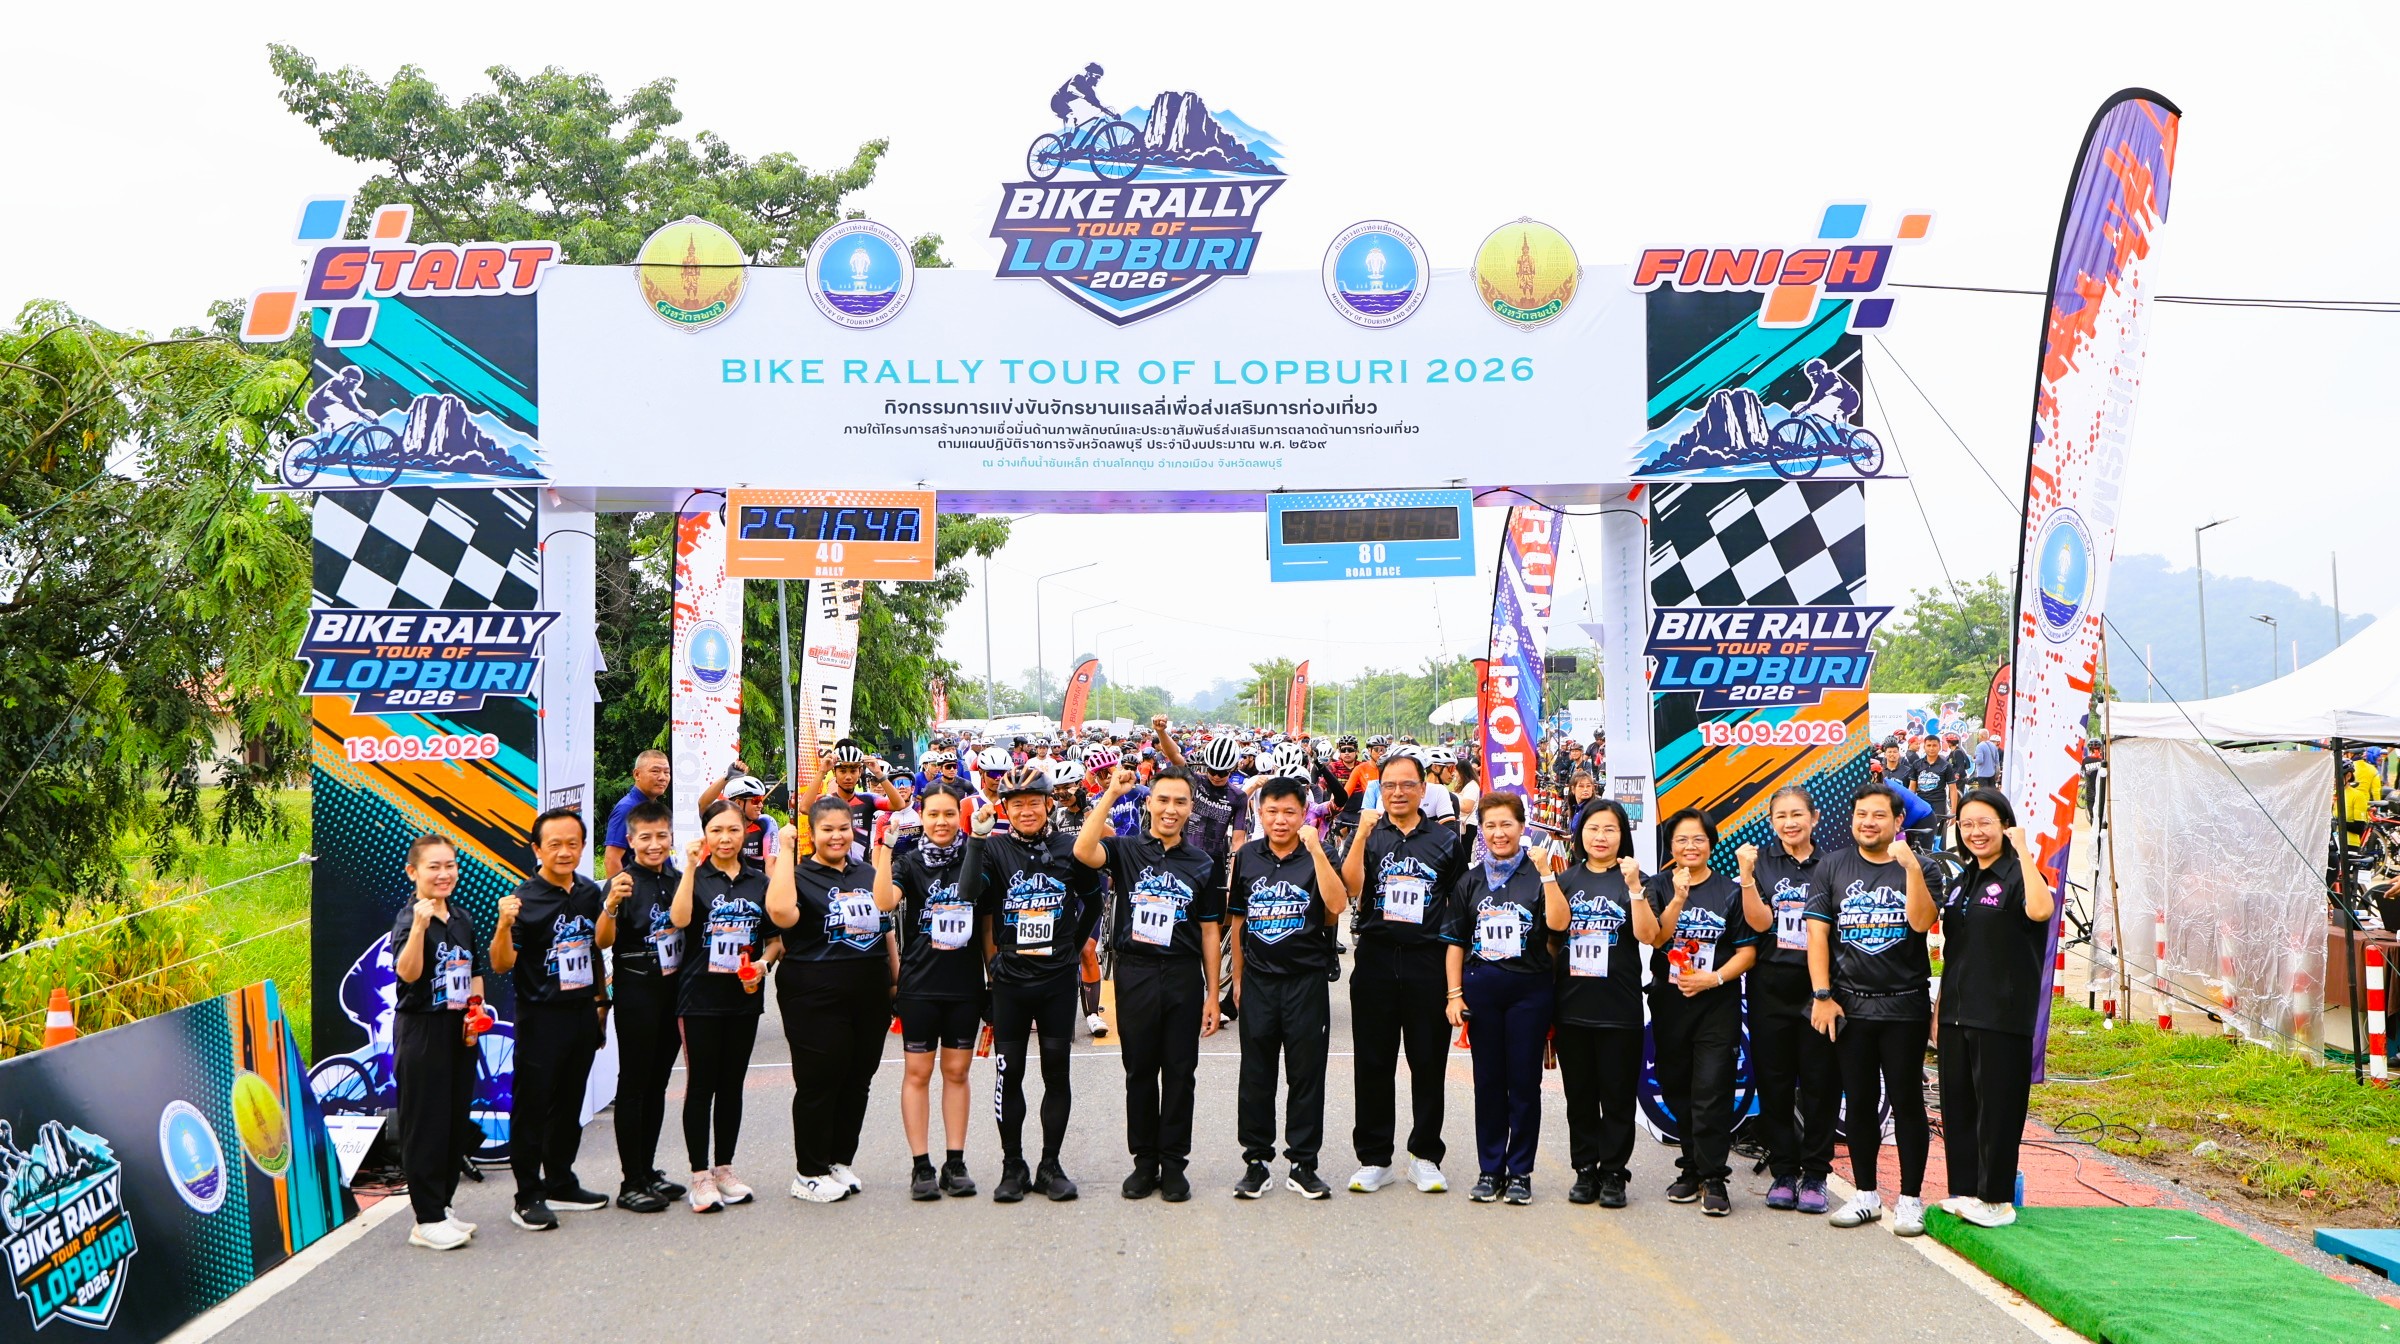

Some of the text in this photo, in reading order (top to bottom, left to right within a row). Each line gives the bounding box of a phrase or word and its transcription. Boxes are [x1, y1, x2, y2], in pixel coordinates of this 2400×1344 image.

[1005, 185, 1273, 220] BIKE RALLY
[1076, 221, 1186, 237] TOUR OF
[1008, 237, 1255, 271] LOPBURI
[321, 247, 554, 291] START
[1633, 248, 1880, 286] FINISH
[1089, 271, 1168, 289] 2026
[657, 303, 723, 324] จังหวัดลพบุรี
[814, 292, 835, 317] MINISTRY
[875, 313, 889, 322] AND
[889, 294, 906, 314] SPORTS
[1331, 292, 1352, 317] MINISTRY
[1364, 317, 1391, 325] TOURISM
[1393, 312, 1405, 321] AND
[1406, 292, 1421, 313] SPORTS
[1495, 302, 1560, 322] จังหวัดลพบุรี
[722, 358, 1535, 384] BIKE RALLY TOUR OF LOPBURI 2026
[884, 395, 1378, 415] กิจกรรมการแข่งขันจักรยานแรลลี่เพื่อส่งเสริมการท่องเที่ยว
[844, 420, 1420, 435] ภายใต้โครงการสร้างความเชื่อมั่นด้านภาพลักษณ์และประชาสัมพันธ์ส่งเสริมการตลาดด้านการท่องเที่ยว
[938, 437, 1327, 452] ตามแผนปฏิบัติราชการจังหวัดลพบุรี ประจำปีงบประมาณ พ.ศ. ๒๕๖๙
[982, 455, 1283, 470] ณ อ่างเก็บน้ำซับเหล็ก ตำบลโคกตูม อำเภอเมือง จังหวัดลพบุรี
[816, 543, 844, 563] 40
[1359, 543, 1386, 564] 80
[815, 567, 844, 577] RALLY
[1345, 566, 1401, 577] ROAD RACE
[1521, 509, 1552, 628] RUN
[311, 614, 553, 644] BIKE RALLY
[1656, 611, 1883, 640] BIKE RALLY
[375, 646, 473, 658] TOUR OF
[1717, 642, 1810, 655] TOUR OF
[313, 658, 533, 690] LOPBURI
[1660, 656, 1867, 685] LOPBURI
[385, 689, 456, 705] 2026
[1729, 685, 1795, 701] 2026
[819, 685, 838, 730] LIFE
[1701, 722, 1845, 744] 13.09.2026
[346, 736, 497, 761] 13.09.2026
[1615, 778, 1644, 794] BIKE RALLY
[550, 786, 584, 809] BIKE RALLY
[1195, 790, 1232, 812] VeloNuts
[1031, 896, 1063, 908] RALLY
[1392, 890, 1418, 905] VIP
[1980, 896, 1999, 906] nbt
[847, 904, 872, 917] VIP
[1140, 910, 1168, 927] VIP
[1271, 904, 1305, 916] RALLY
[1840, 913, 1869, 925] BIKE
[938, 919, 967, 934] VIP
[1019, 922, 1051, 939] R350
[1250, 918, 1304, 930] LOPBURI
[1486, 925, 1513, 940] VIP
[1570, 920, 1620, 930] KE RALLY
[1843, 927, 1908, 940] LOPBURI
[855, 932, 875, 941] 2026
[1685, 930, 1722, 939] RALLY
[664, 937, 683, 957] VIP
[1575, 944, 1602, 959] VIP
[566, 953, 589, 972] VIP
[995, 1074, 1004, 1122] SCOTT
[10, 1216, 64, 1276] BIKE
[62, 1175, 119, 1240] RALLY
[51, 1226, 98, 1268] TOUR OF
[30, 1219, 134, 1318] LOPBURI
[77, 1270, 110, 1306] 2026
